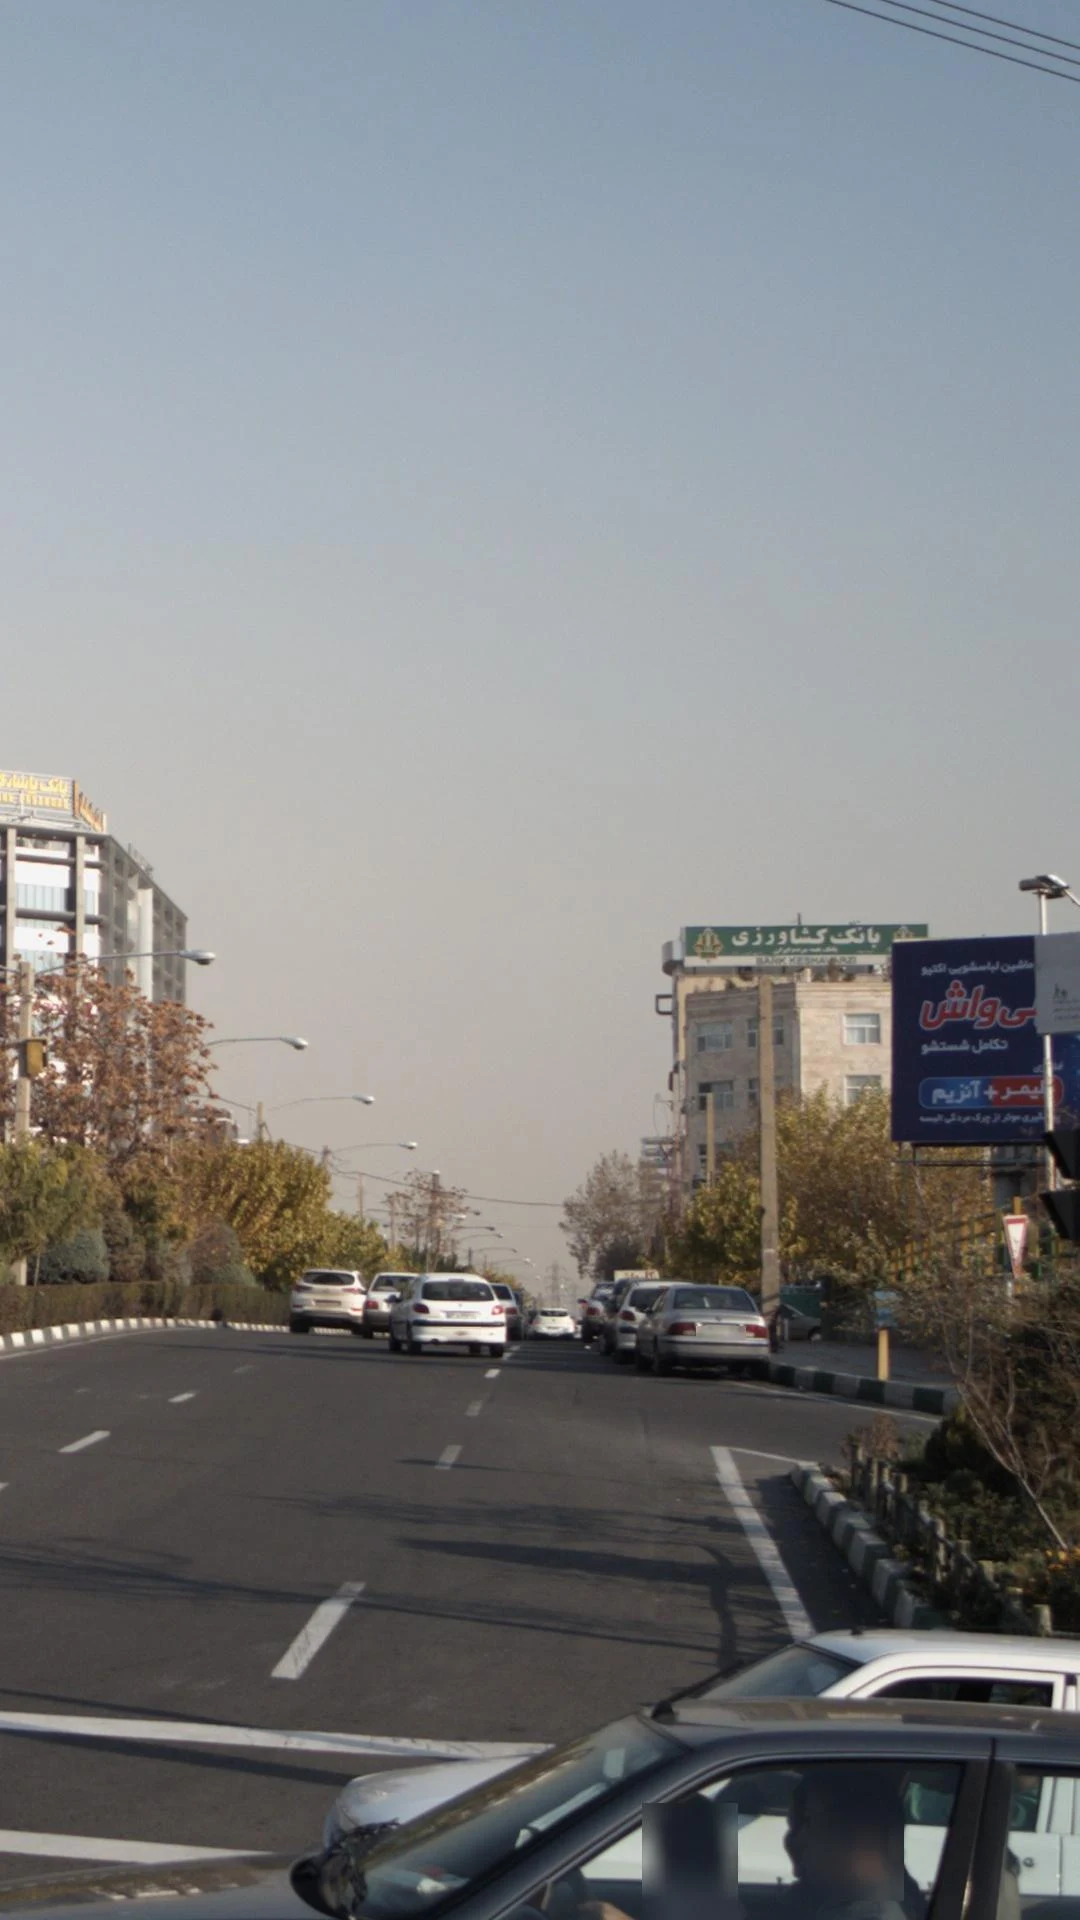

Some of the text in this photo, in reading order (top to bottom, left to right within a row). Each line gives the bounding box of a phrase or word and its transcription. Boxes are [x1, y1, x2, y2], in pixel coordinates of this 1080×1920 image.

[731, 927, 880, 948] بانک کشاورزی
[1001, 959, 1034, 973] ماشین
[920, 1038, 1008, 1055] تکامل شستشو
[931, 1080, 981, 1105] آنزیم
